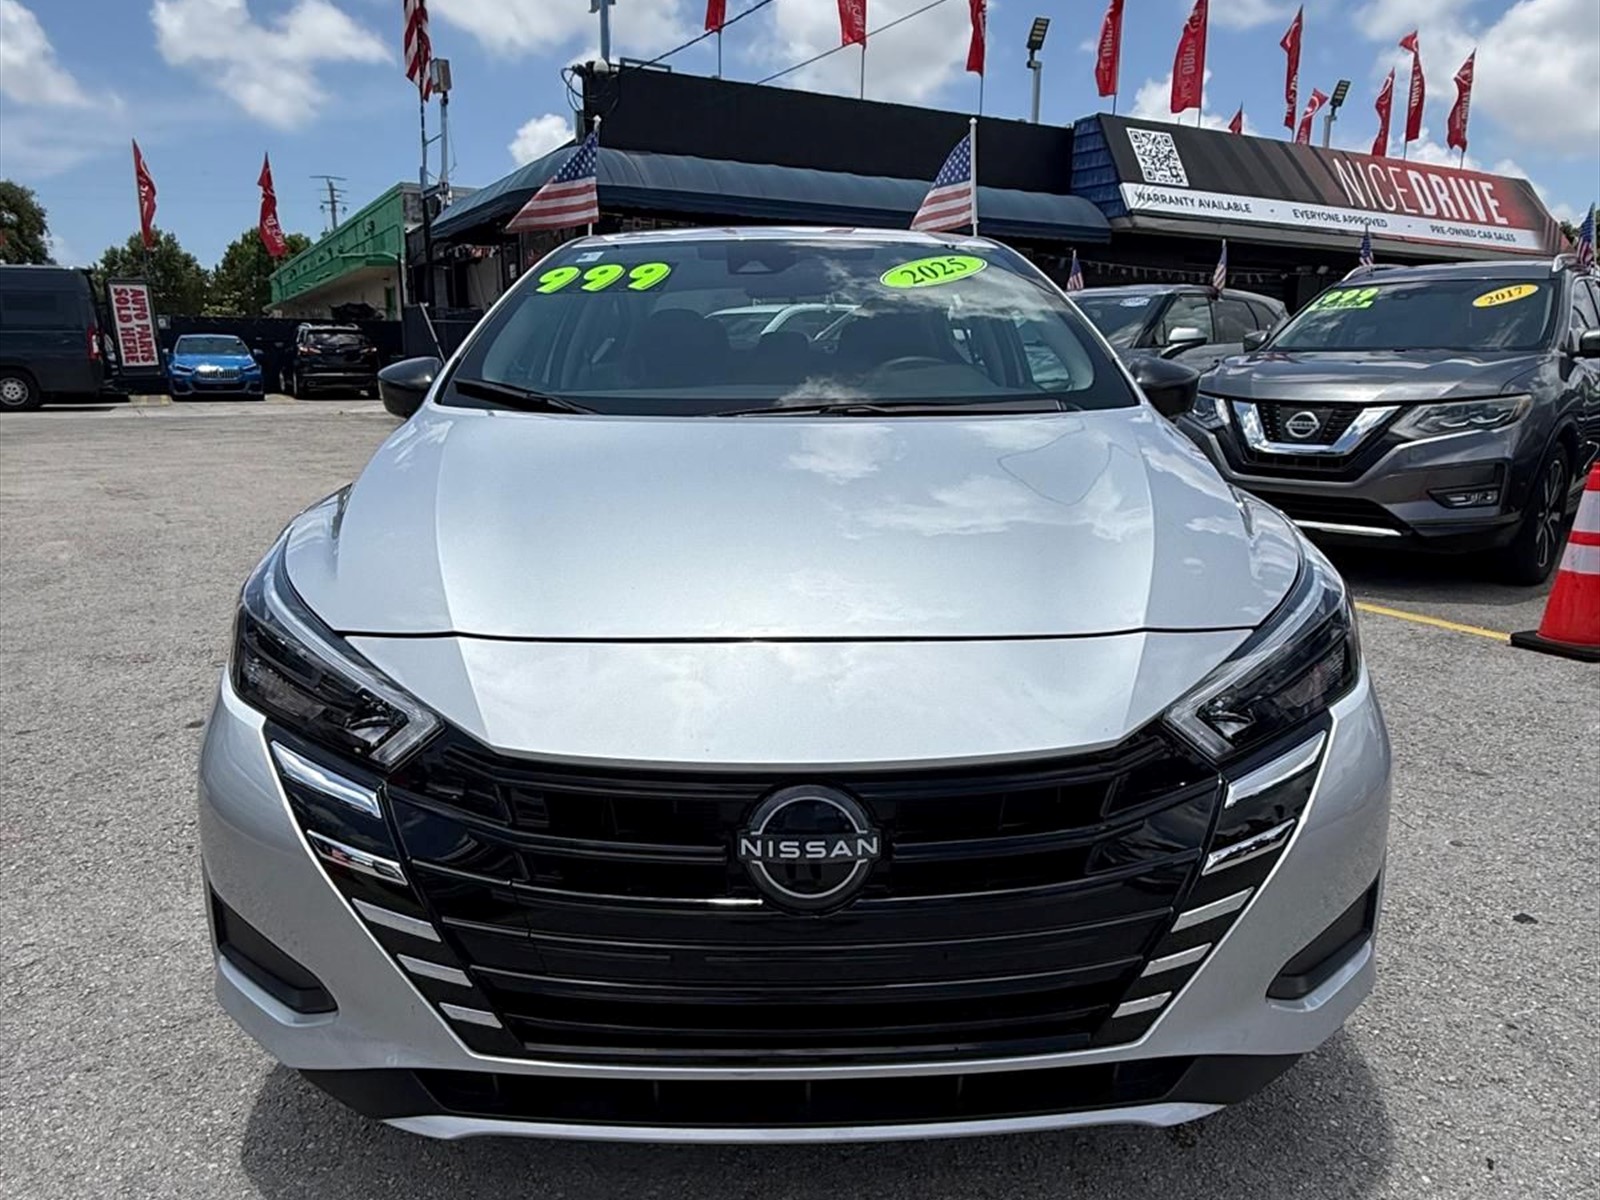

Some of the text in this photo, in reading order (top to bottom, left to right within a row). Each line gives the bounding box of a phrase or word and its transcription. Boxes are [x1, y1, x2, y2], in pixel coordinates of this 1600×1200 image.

[1134, 191, 1516, 242] WARRANTY AVAILABLE EVERYONE APPROVED PRE-OWNED CAR SALES
[536, 262, 672, 293] 999
[900, 257, 968, 284] 2025
[1321, 287, 1379, 305] 999
[1485, 286, 1523, 304] 2017
[113, 287, 140, 364] SOLD HERE
[129, 288, 156, 363] AUTO PARTS
[740, 836, 878, 859] NISSAN
